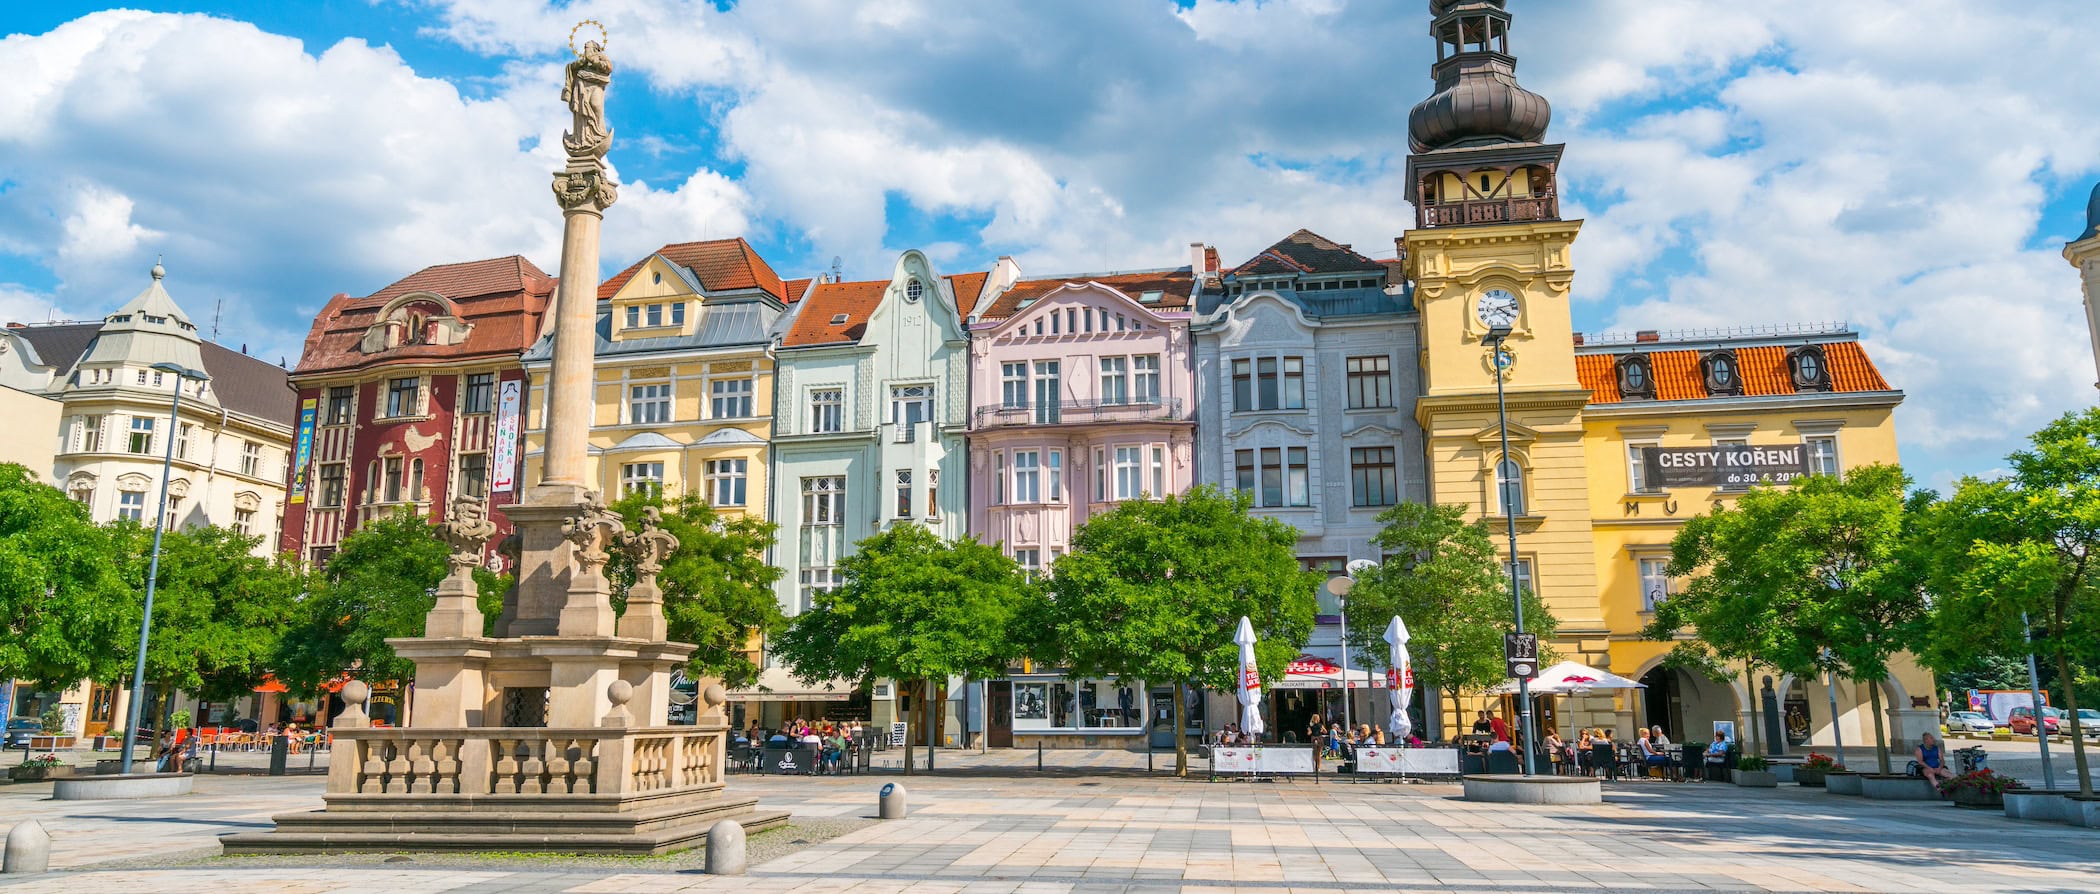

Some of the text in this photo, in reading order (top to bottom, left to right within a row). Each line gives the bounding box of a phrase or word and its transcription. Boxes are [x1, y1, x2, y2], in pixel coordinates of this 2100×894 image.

[1659, 447, 1800, 468] CESTY KOŘENÍ
[1728, 473, 1740, 483] do
[1743, 473, 1760, 483] 30.
